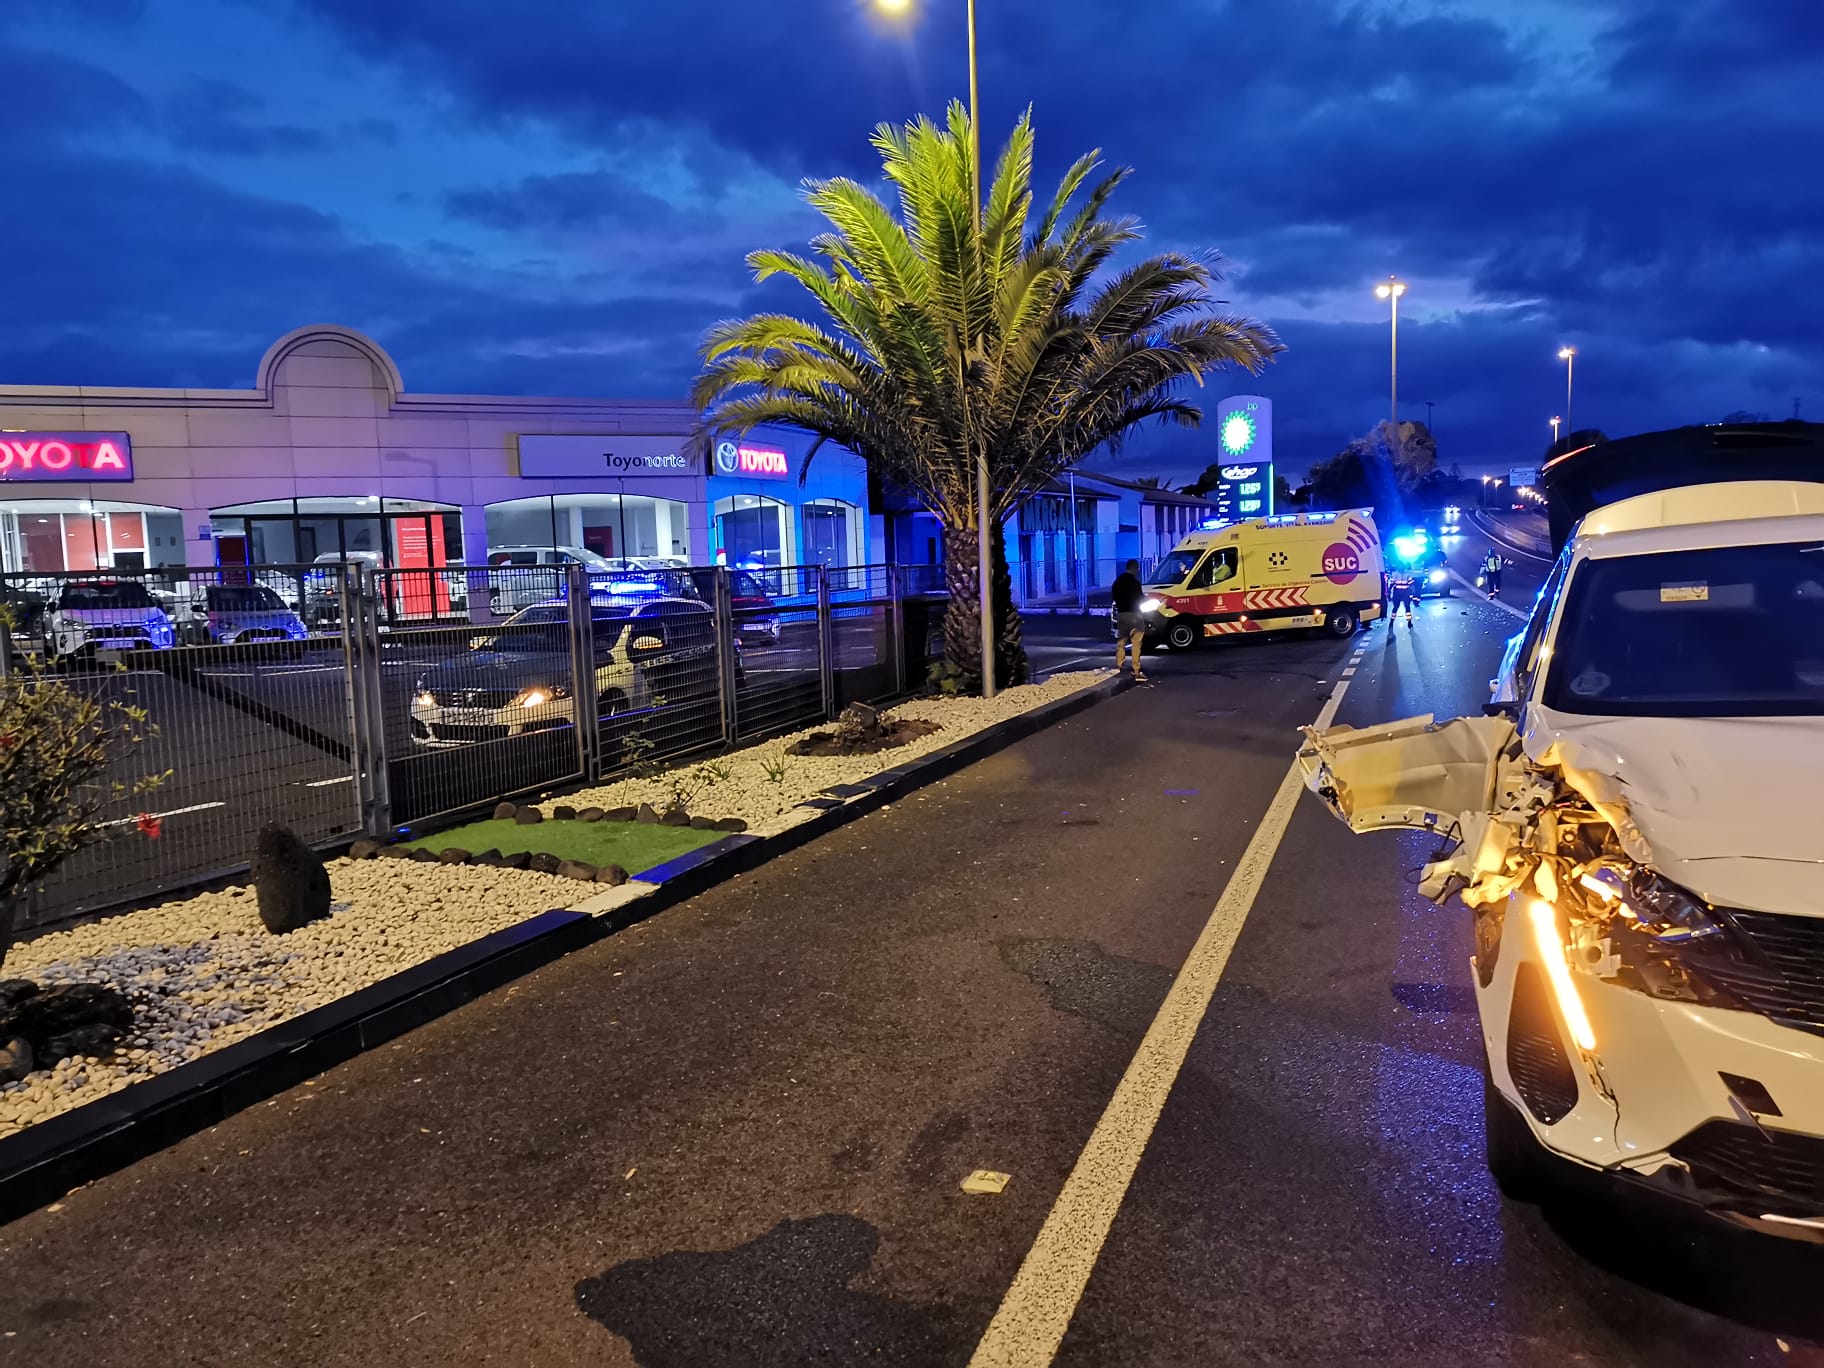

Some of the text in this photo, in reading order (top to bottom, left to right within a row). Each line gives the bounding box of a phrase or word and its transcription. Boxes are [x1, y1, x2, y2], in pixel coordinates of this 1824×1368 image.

[603, 453, 686, 471] Toyonorte
[738, 449, 787, 473] TOYOTA
[1324, 556, 1357, 571] SUC
